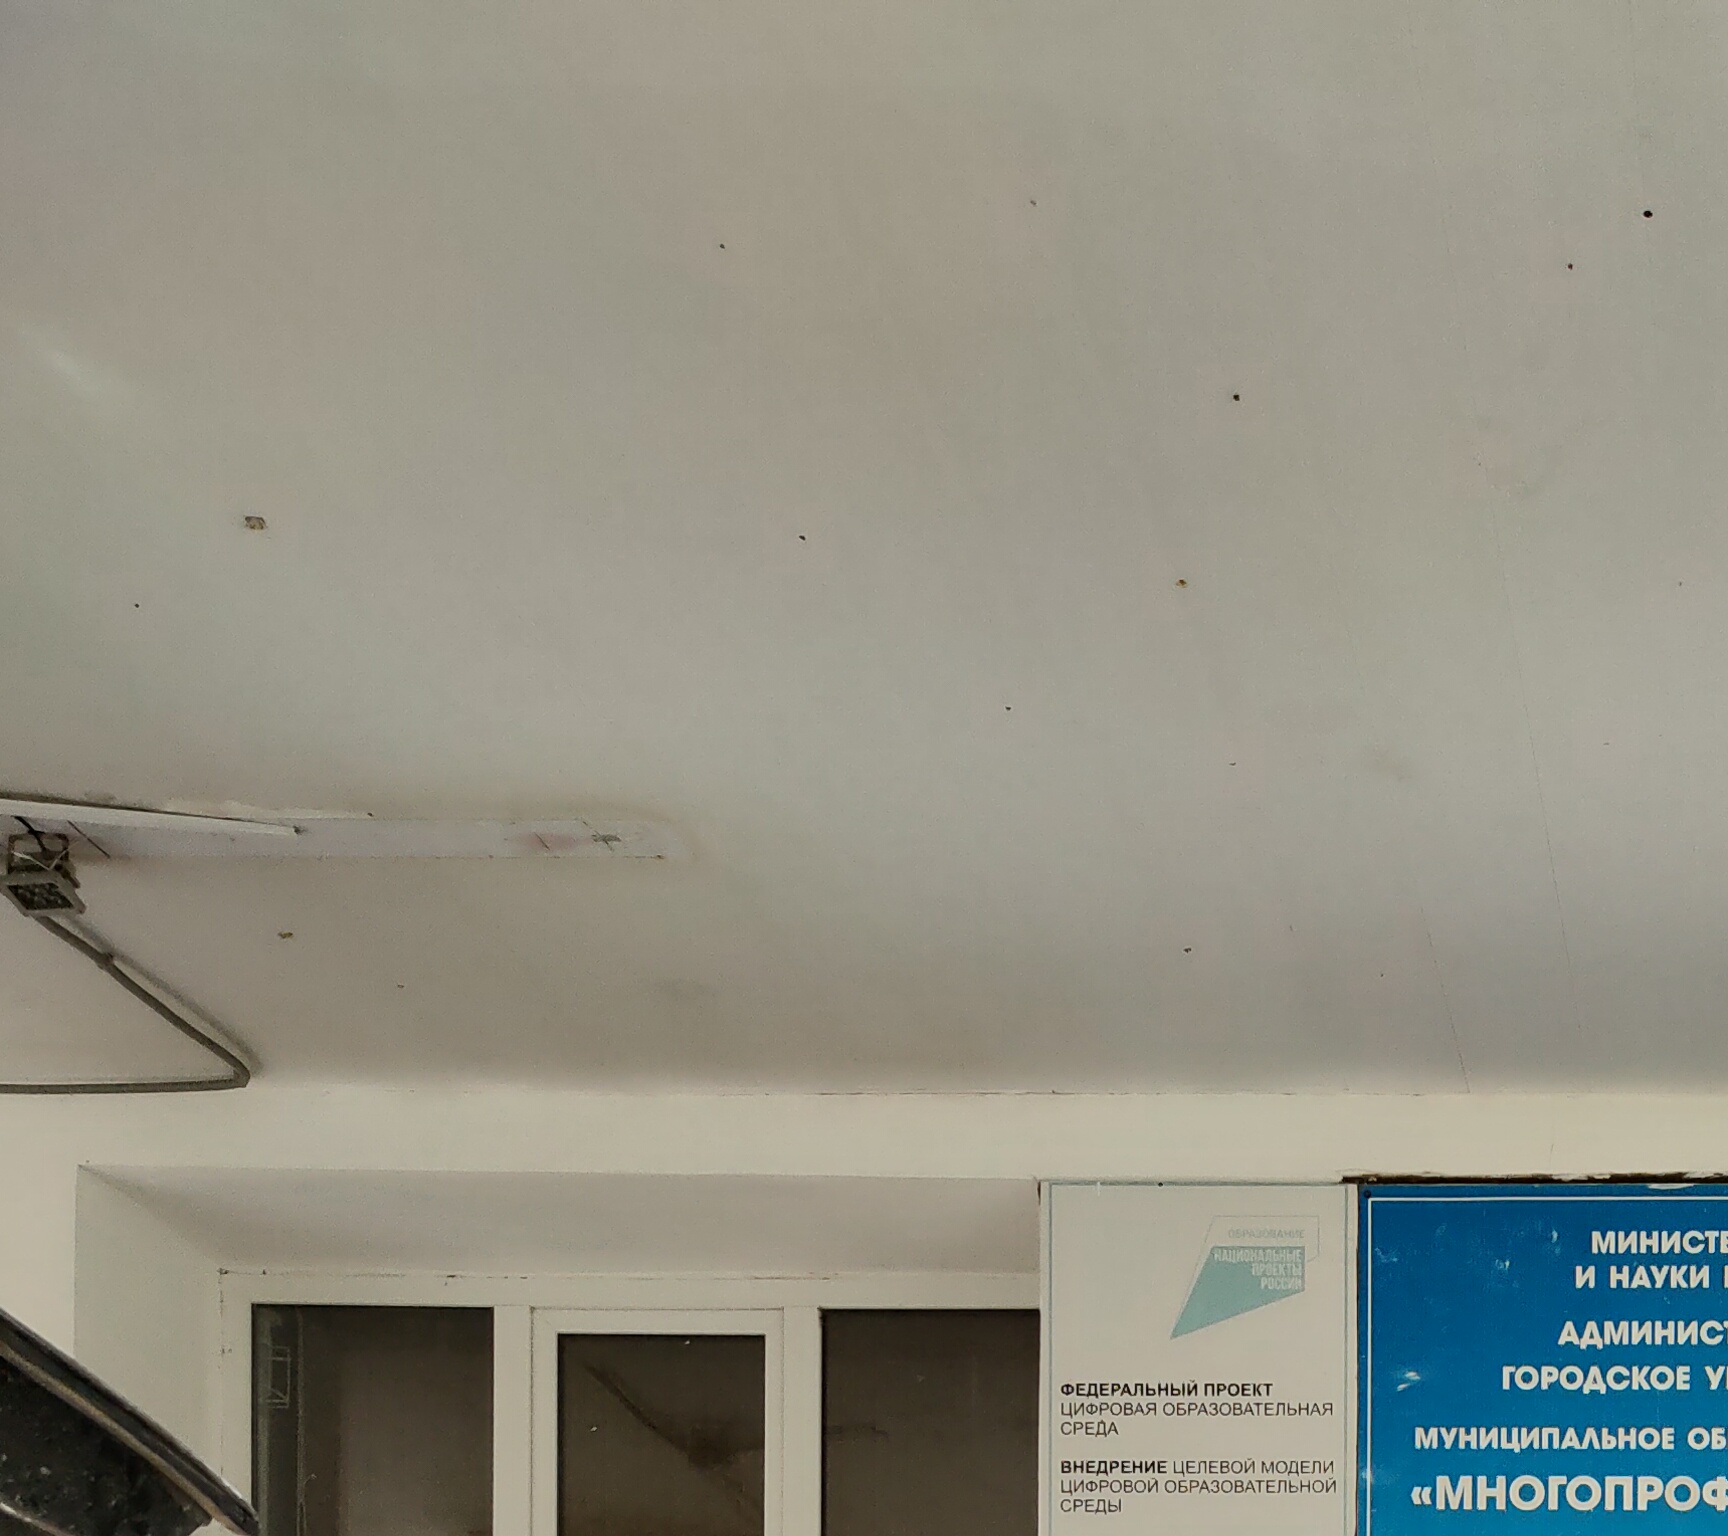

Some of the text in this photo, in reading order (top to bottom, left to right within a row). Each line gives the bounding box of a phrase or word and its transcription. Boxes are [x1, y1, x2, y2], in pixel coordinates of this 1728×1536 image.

[1251, 1262, 1302, 1276] ПРОЕКТЫ
[1575, 1265, 1596, 1289] И
[1609, 1264, 1710, 1289] НАУКИ
[1502, 1365, 1691, 1395] ГОРОДСКОЕ
[1060, 1382, 1274, 1399] ФЕДЕРАЛЬНЫЙ ПРОЕКТ
[1060, 1401, 1333, 1420] ЦИФРОВАЯ ОБРАЗОВАТЕЛЬНАЯ
[1060, 1419, 1119, 1438] СРЕДА
[1414, 1426, 1675, 1454] МУНИЦИПАЛЬНОЕ
[1060, 1457, 1334, 1478] ВНЕДРЕНИЕ ЦЕЛЕВОЙ МОДЕЛИ
[1060, 1476, 1337, 1497] ЦИФРОВОЙ ОБРАЗОВАТЕЛЬНОЙ
[1060, 1498, 1122, 1516] СРЕДЫ
